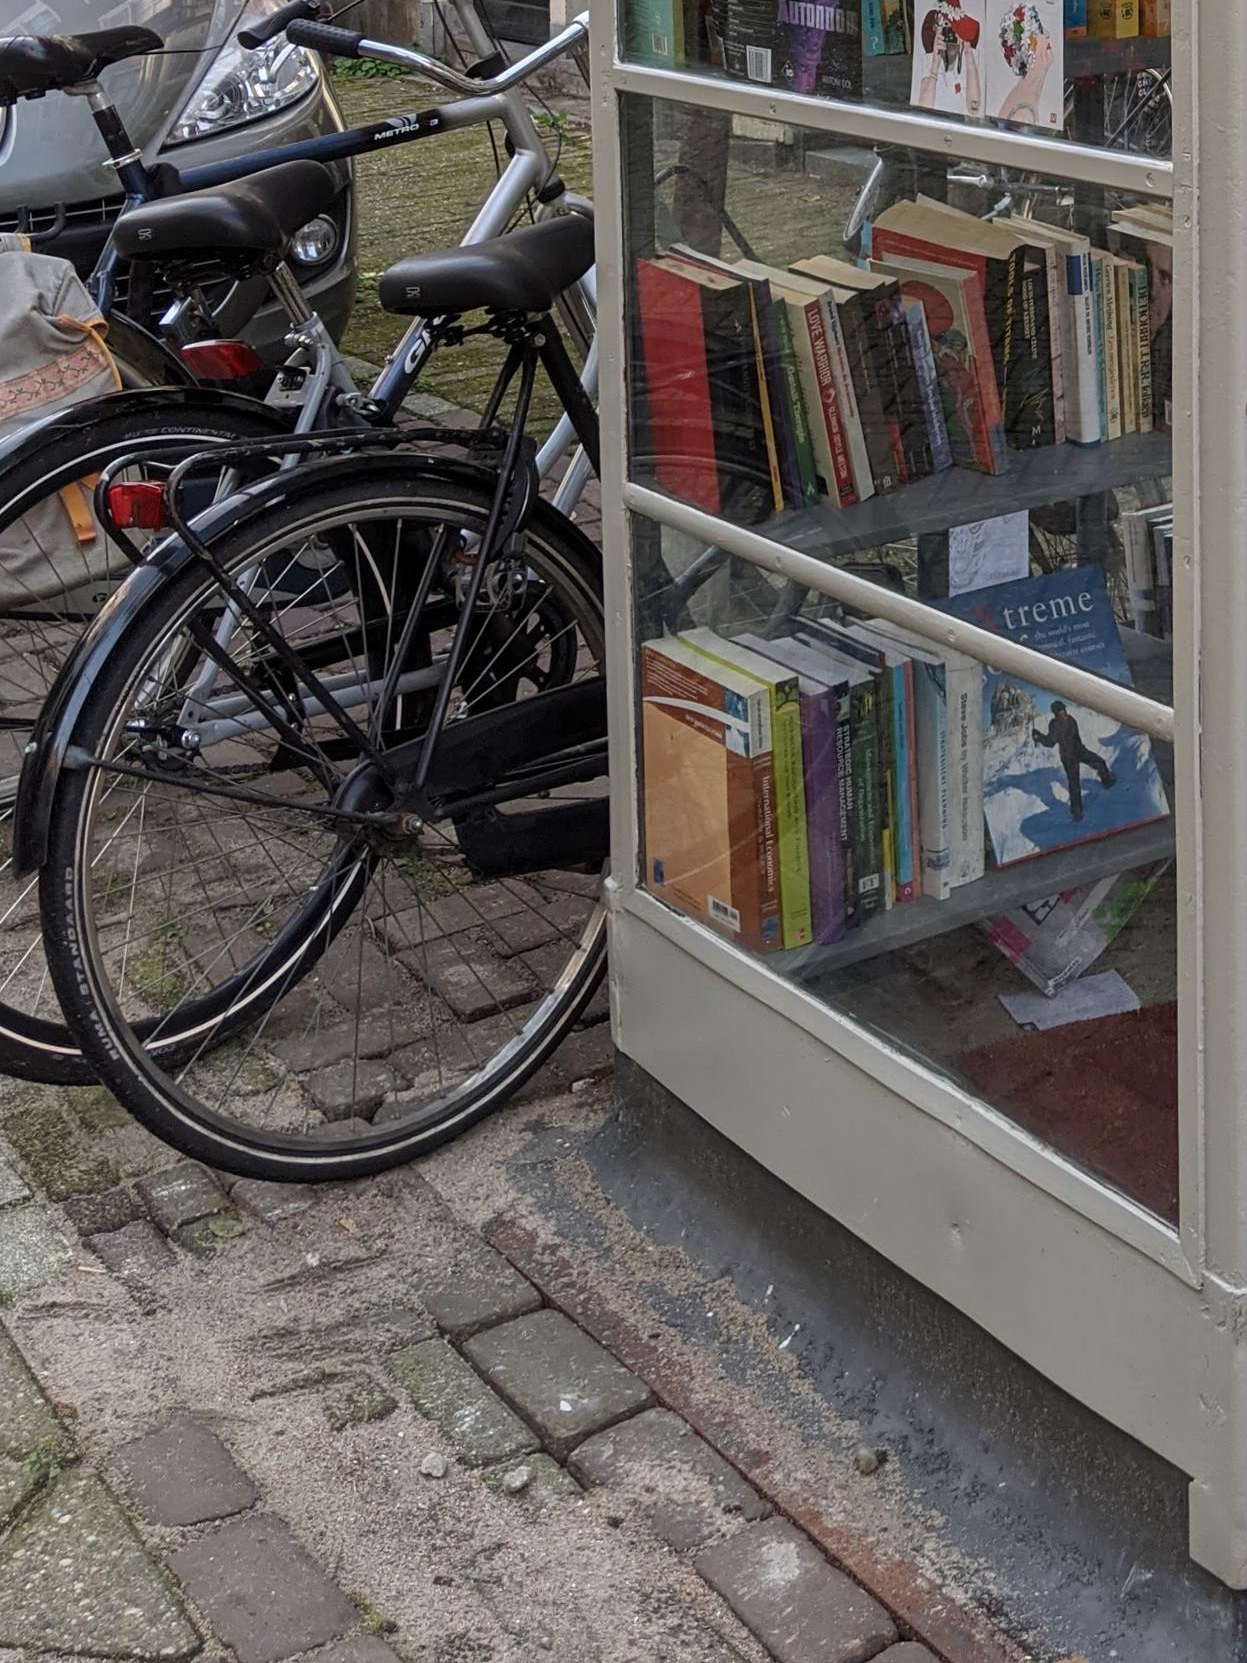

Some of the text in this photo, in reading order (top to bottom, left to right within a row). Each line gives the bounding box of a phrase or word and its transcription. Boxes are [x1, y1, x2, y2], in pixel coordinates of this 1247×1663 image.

[373, 123, 420, 141] METRO
[807, 307, 832, 386] LOVE WARRIOR
[960, 692, 969, 720] Steve
[842, 724, 852, 775] STRATEGIC
[960, 723, 969, 749] Jobs
[836, 727, 848, 841] RESOURCE MANAGEMENT
[762, 775, 776, 893] International Economics
